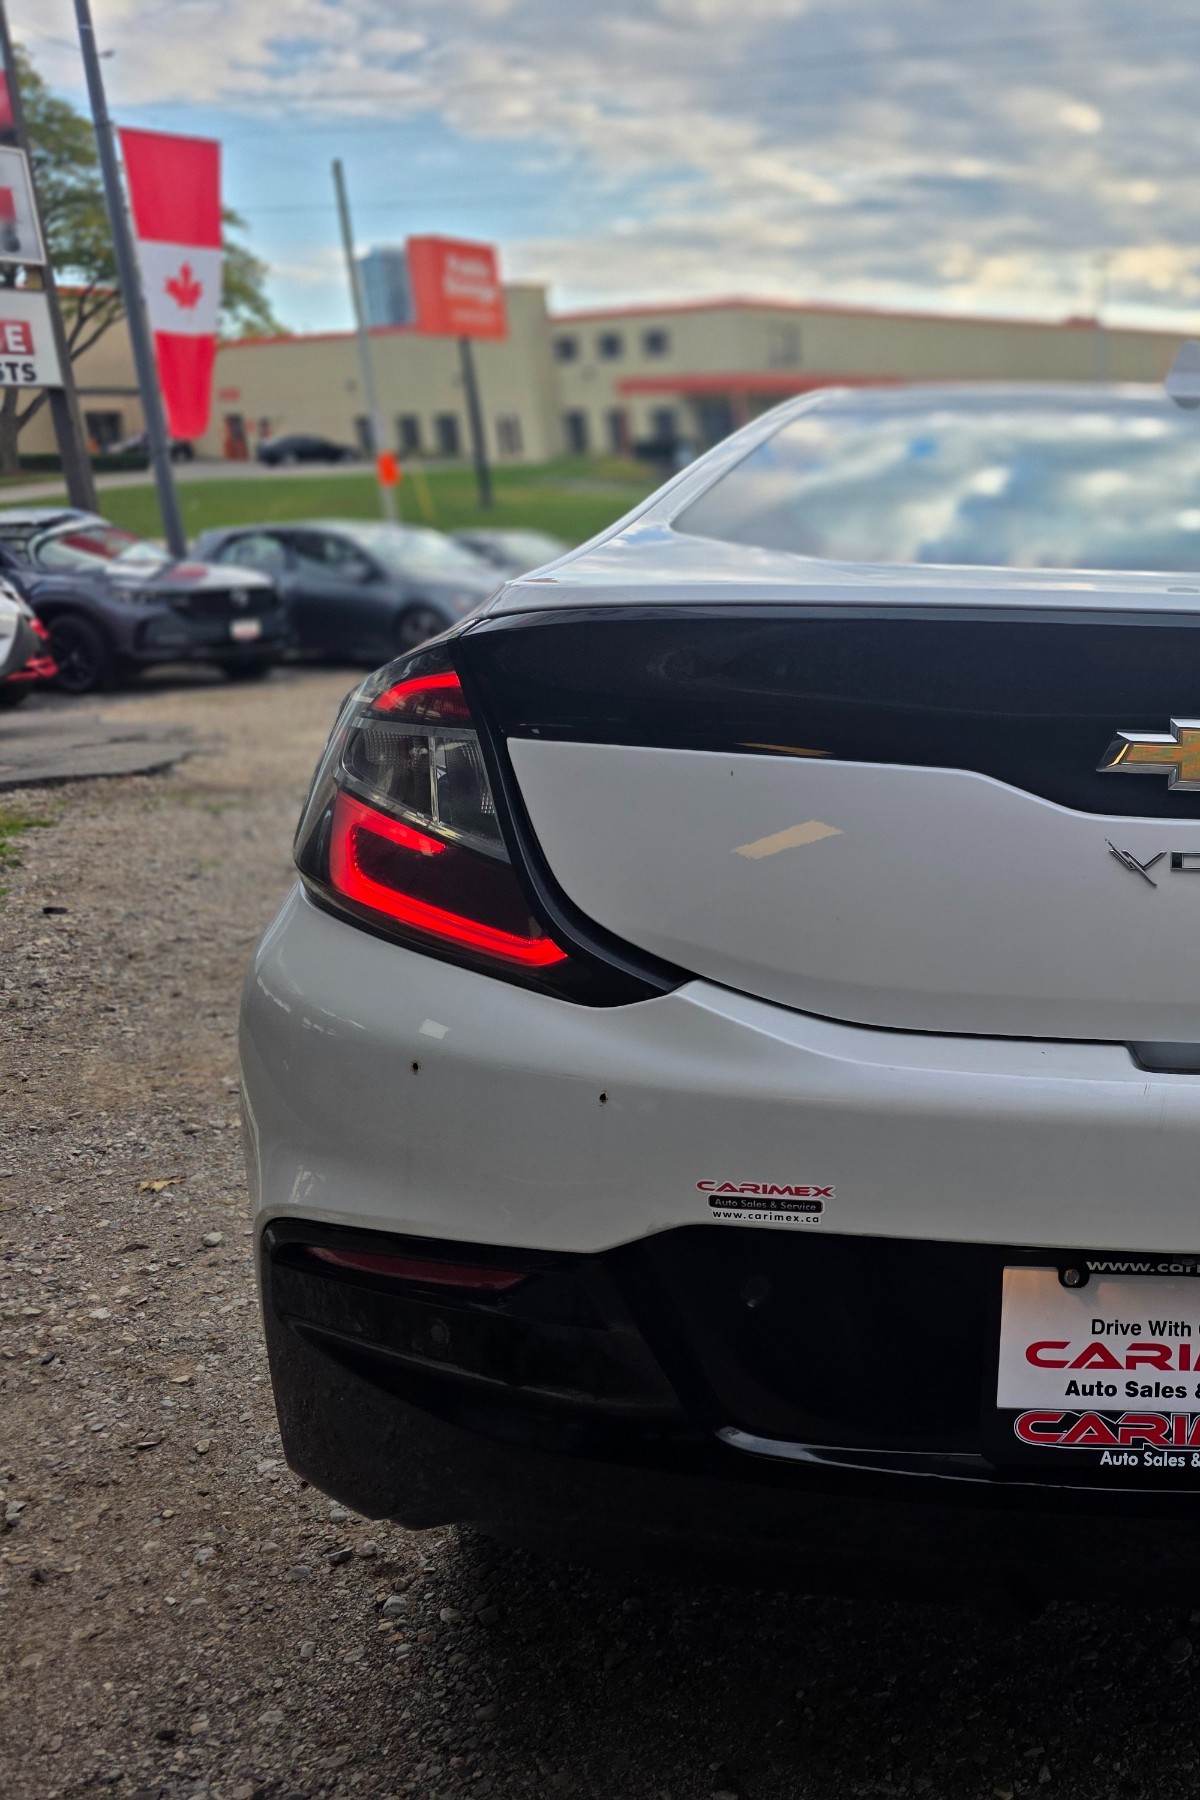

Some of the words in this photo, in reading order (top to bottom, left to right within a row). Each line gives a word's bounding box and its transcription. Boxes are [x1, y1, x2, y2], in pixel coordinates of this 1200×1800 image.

[696, 1180, 835, 1198] CARIMEX
[714, 1198, 738, 1207] Auto
[741, 1199, 767, 1208] Sales
[770, 1201, 778, 1209] &
[780, 1201, 817, 1211] Service
[712, 1210, 820, 1223] www.carimex.ca
[1091, 1318, 1142, 1336] Drive
[1148, 1320, 1192, 1337] With
[1065, 1380, 1118, 1398] Auto
[1124, 1381, 1188, 1399] Sales
[1099, 1450, 1139, 1466] Auto
[1143, 1451, 1186, 1468] Sales
